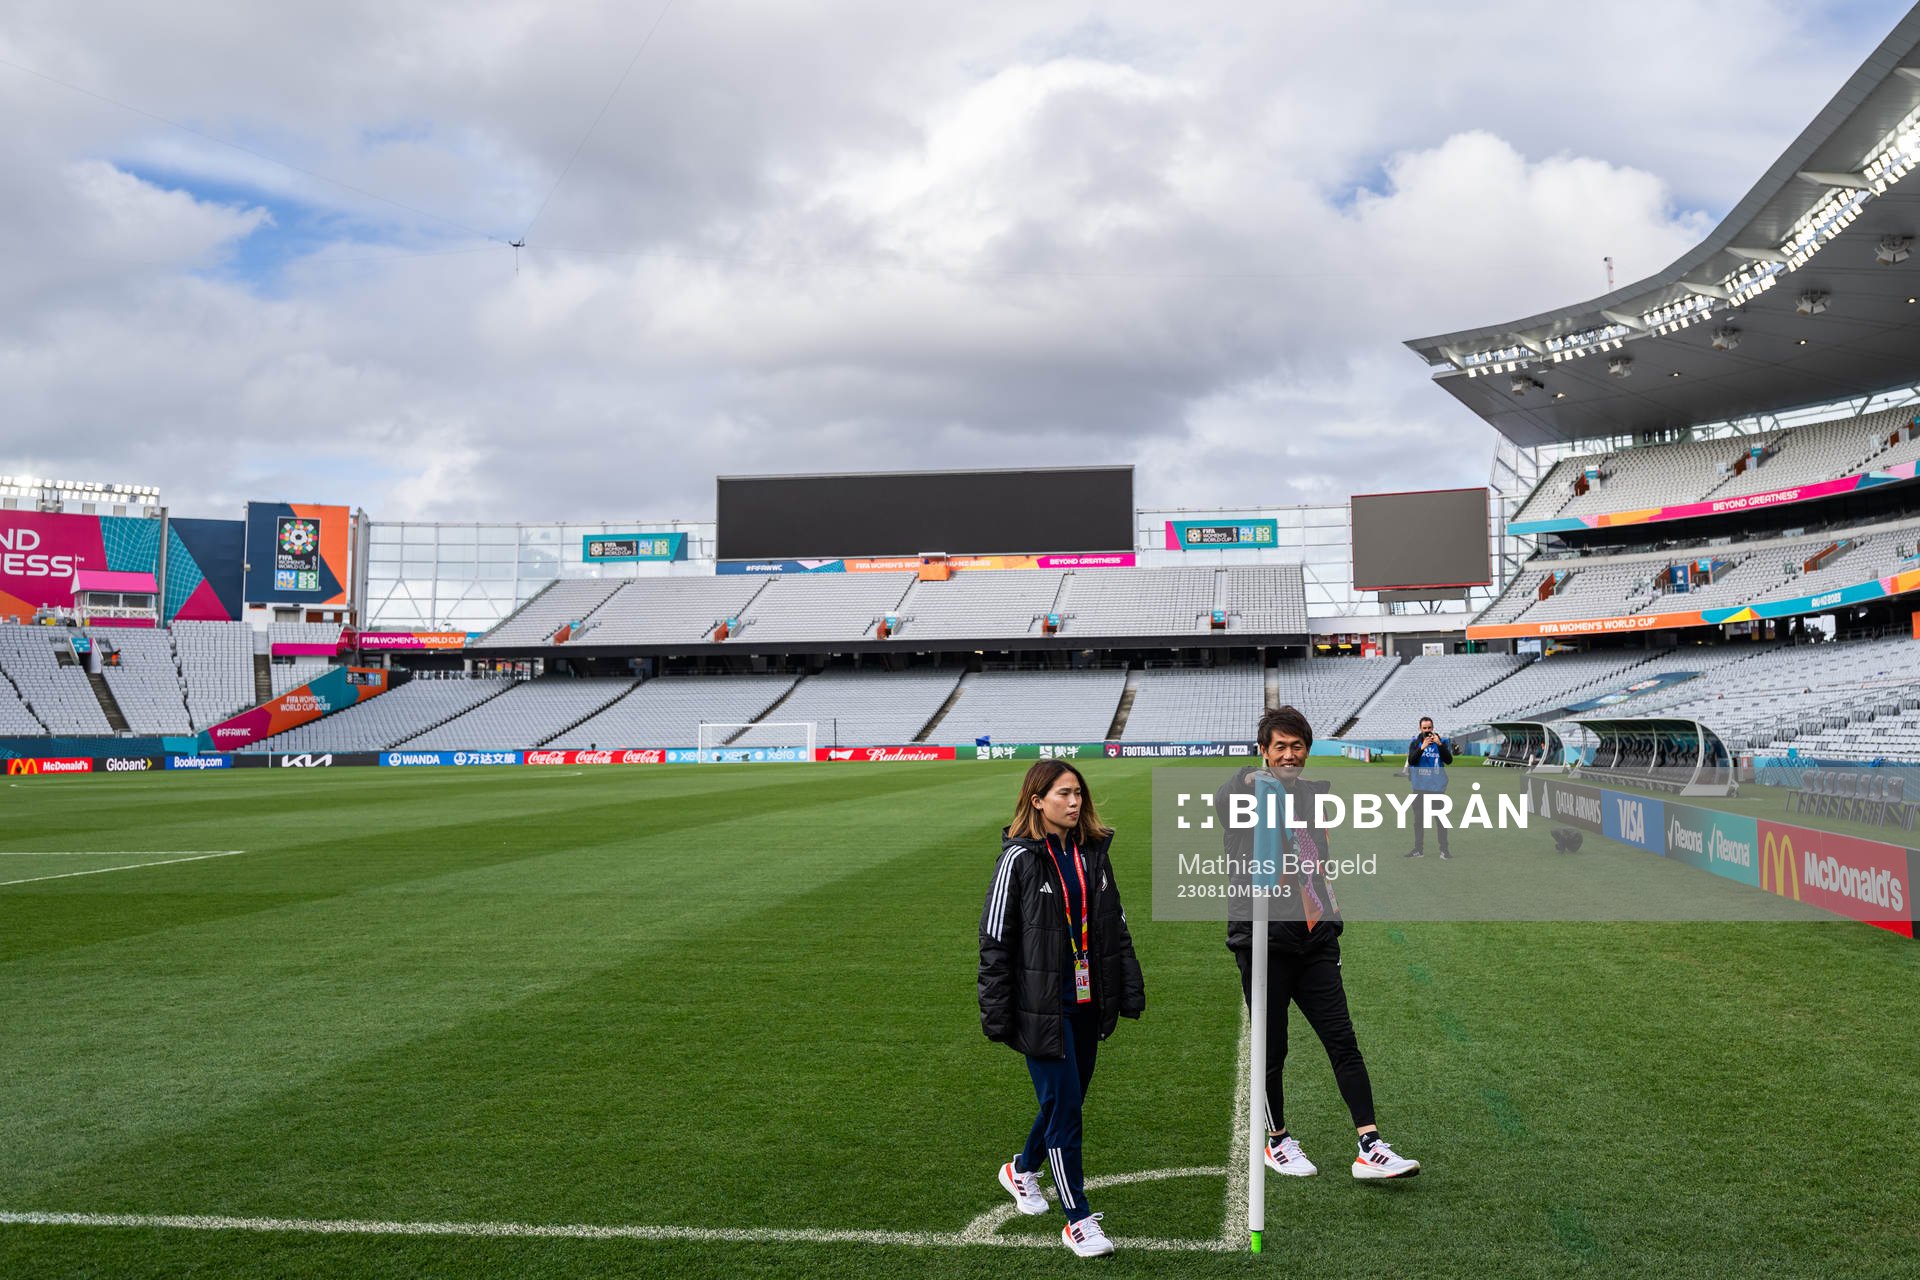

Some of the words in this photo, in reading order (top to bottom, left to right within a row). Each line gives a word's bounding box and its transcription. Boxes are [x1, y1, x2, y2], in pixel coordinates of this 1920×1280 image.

[1712, 499, 1747, 511] BEYOND
[1540, 624, 1559, 633] FIFA
[1560, 621, 1602, 632] WOMEN'S
[1604, 619, 1636, 629] WORLD
[380, 636, 418, 644] WOMEN'S
[866, 748, 938, 761] Budweiser
[1122, 747, 1159, 756] FOOTBALL
[1160, 746, 1187, 755] UNITES
[1188, 745, 1202, 755] the
[1202, 744, 1225, 756] World
[42, 761, 88, 771] McDonald's
[106, 758, 146, 771] Globant
[173, 756, 223, 768] Booking.com
[402, 756, 440, 765] WANDA
[1555, 790, 1575, 816] QATAR
[1575, 796, 1601, 824] AIRWAYS
[1617, 799, 1645, 844] VISA
[1674, 819, 1702, 854] Rexona
[1716, 829, 1750, 868] Rexona
[1804, 851, 1904, 912] McDonald's
